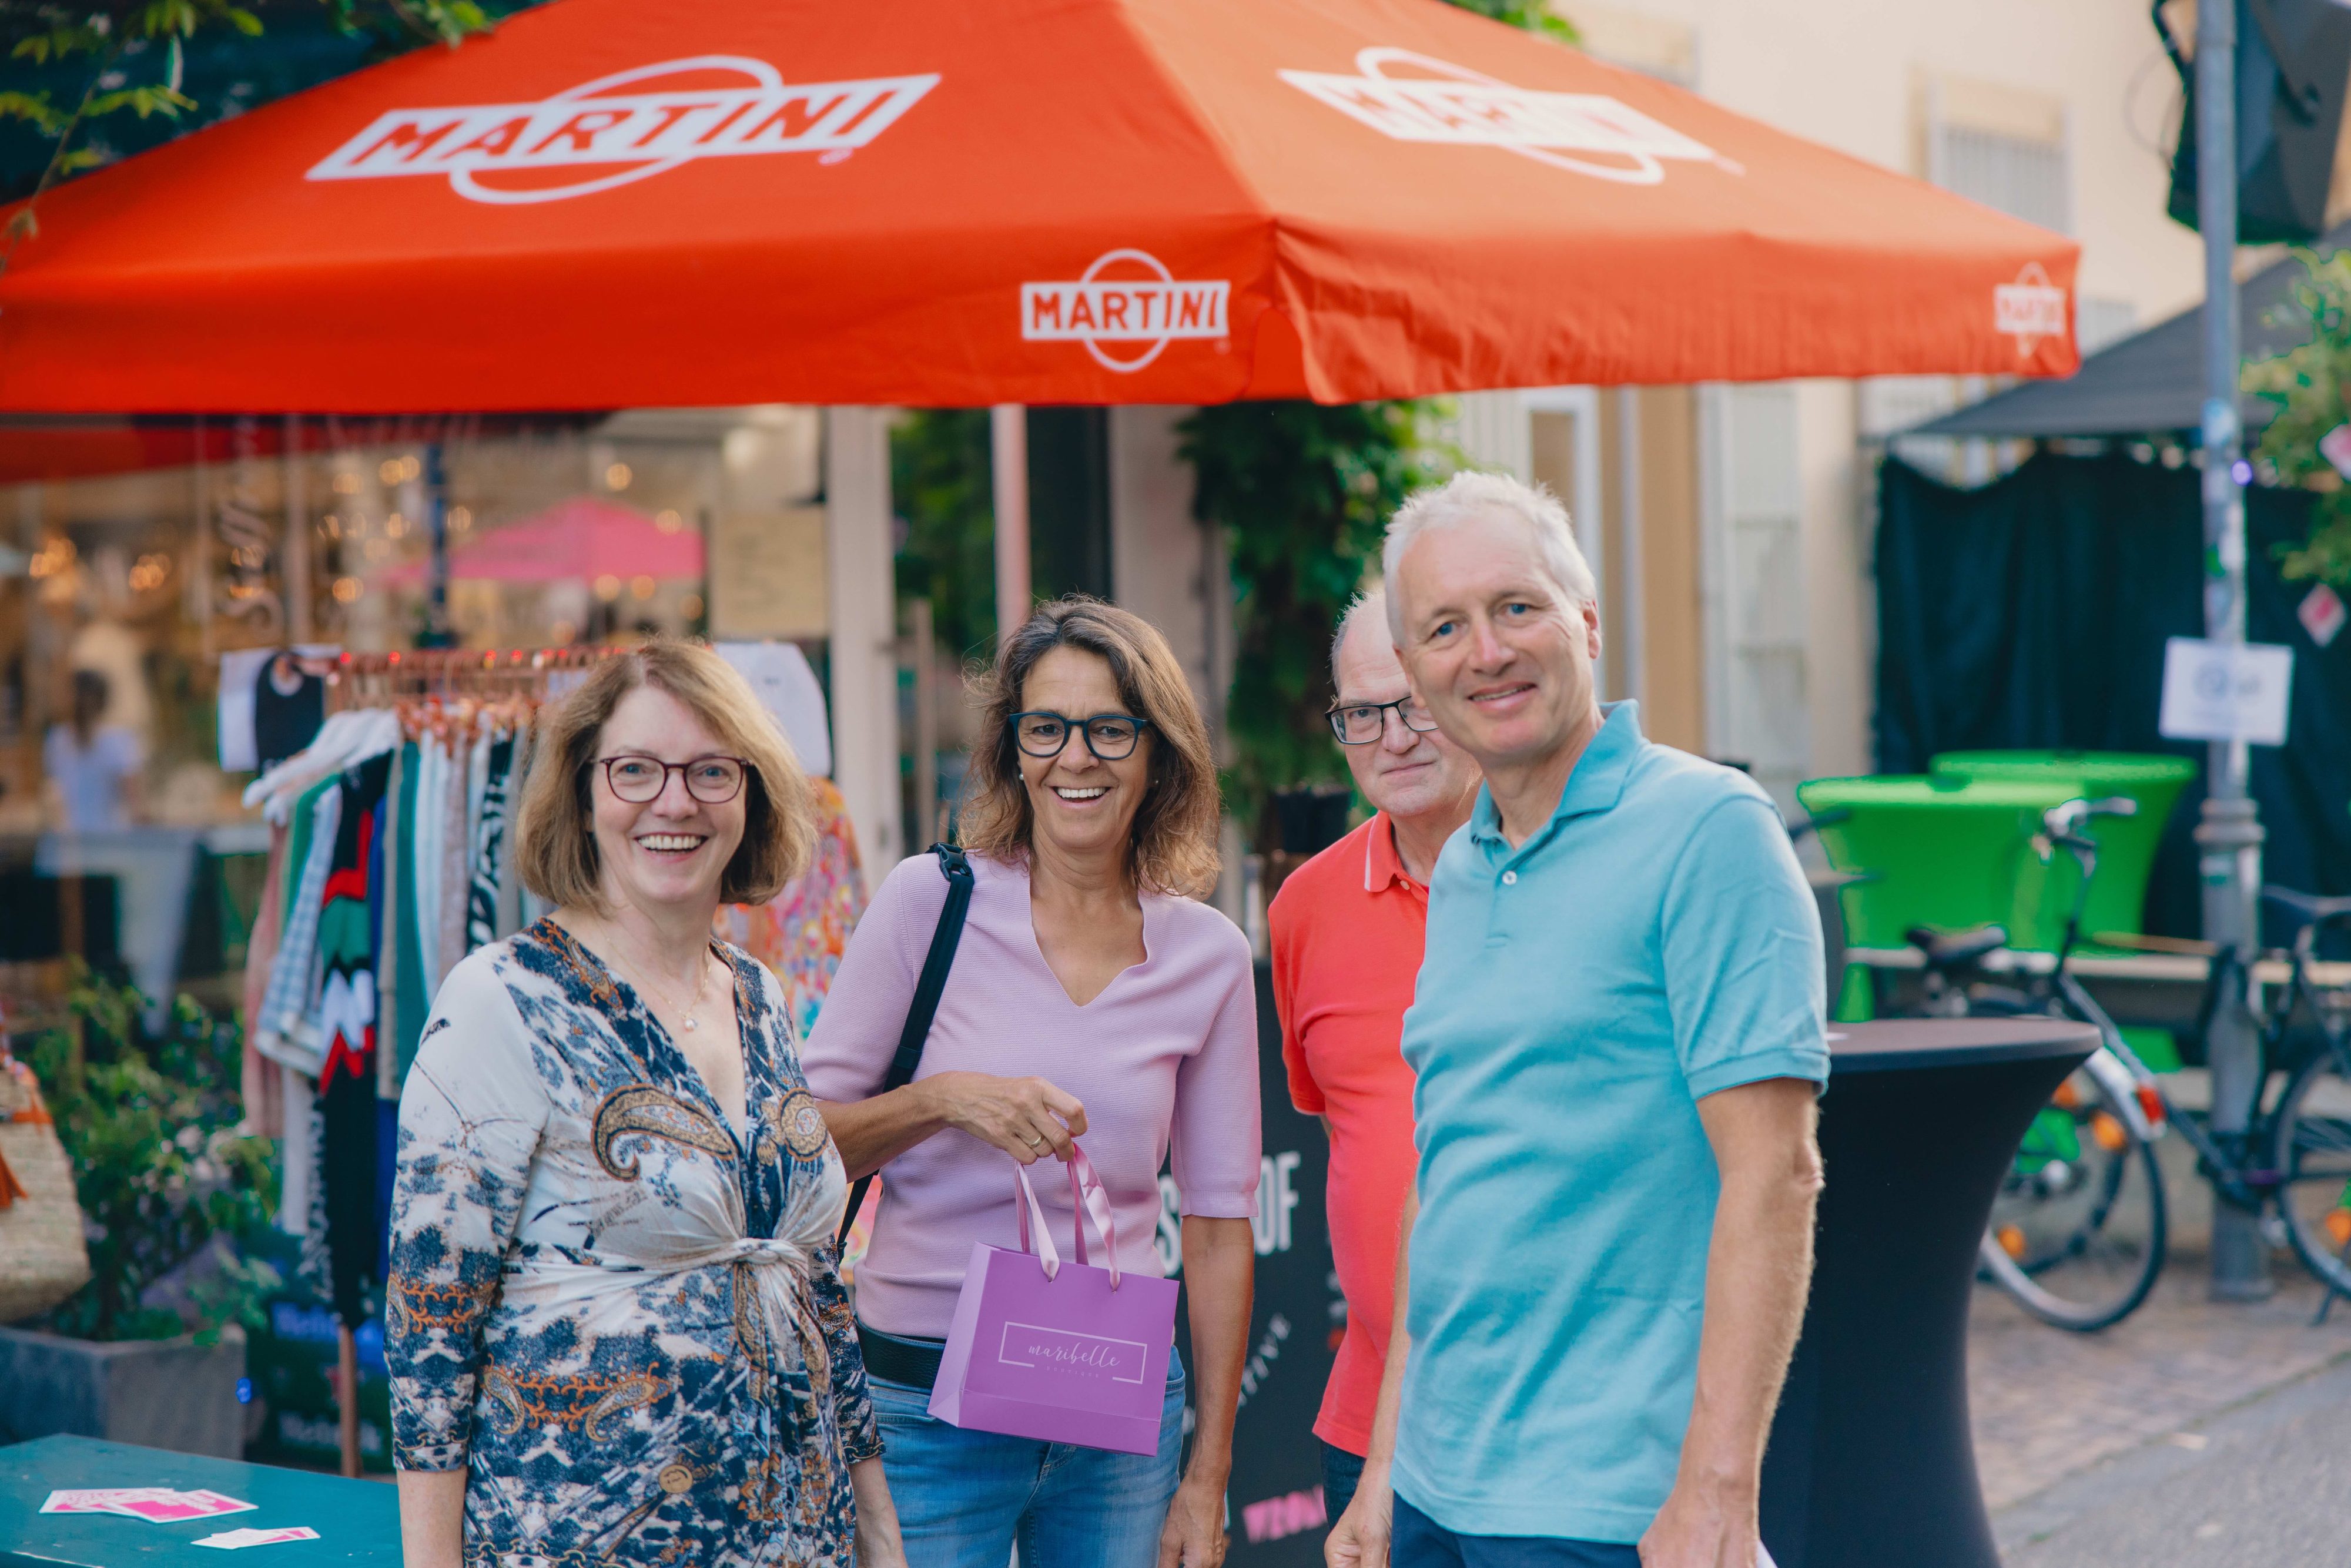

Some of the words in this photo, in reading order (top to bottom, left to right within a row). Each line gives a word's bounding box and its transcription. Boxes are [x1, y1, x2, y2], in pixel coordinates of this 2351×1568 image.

[347, 88, 902, 167] MARTINI
[1032, 289, 1218, 331] MARTINI
[1029, 1342, 1121, 1368] maribelle
[1046, 1365, 1100, 1378] BOUTIQUE
